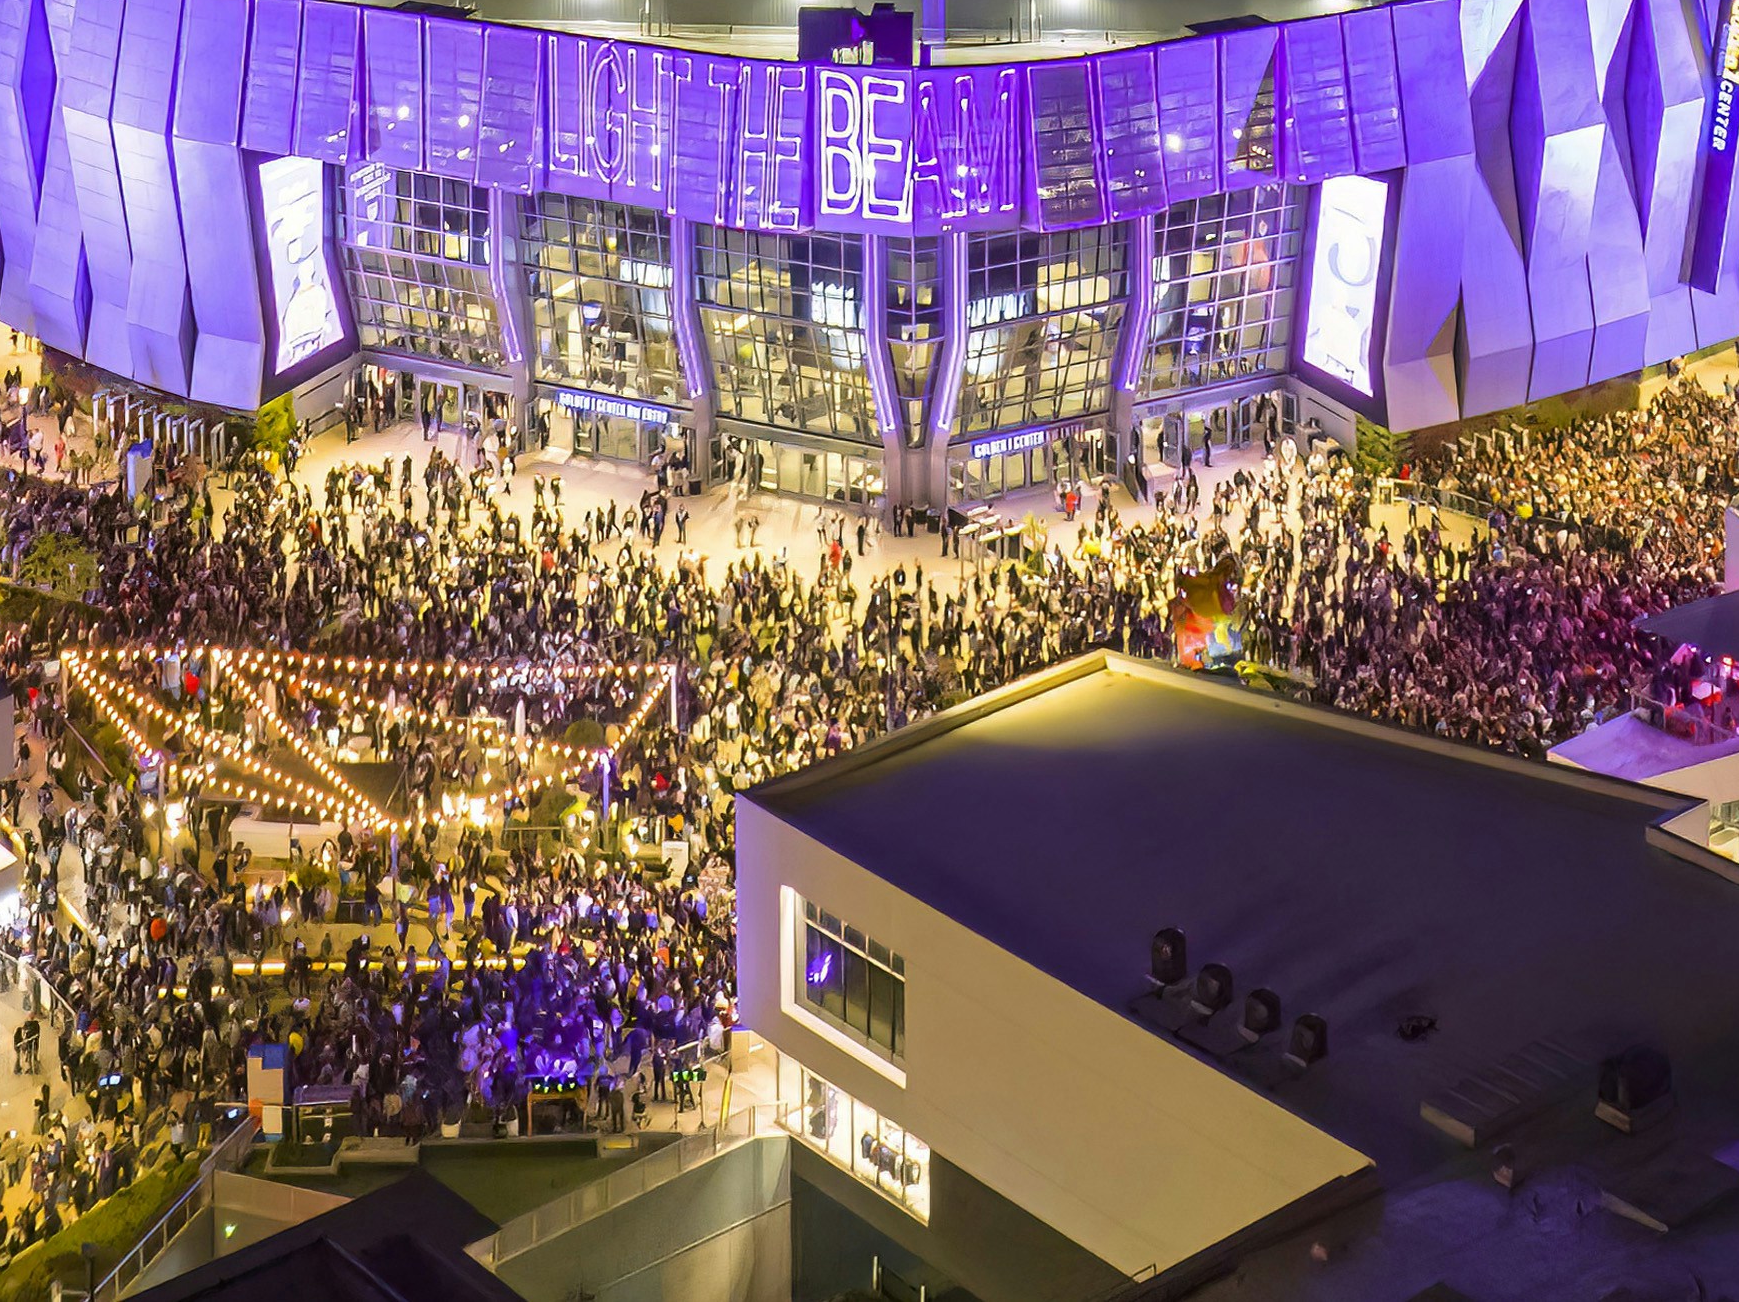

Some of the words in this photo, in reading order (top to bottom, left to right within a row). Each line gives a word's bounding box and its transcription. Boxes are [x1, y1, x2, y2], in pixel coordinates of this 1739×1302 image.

[548, 35, 692, 215] LIGHT
[708, 62, 806, 230] THE
[819, 69, 1017, 219] BEAM
[1712, 82, 1734, 152] CENTER
